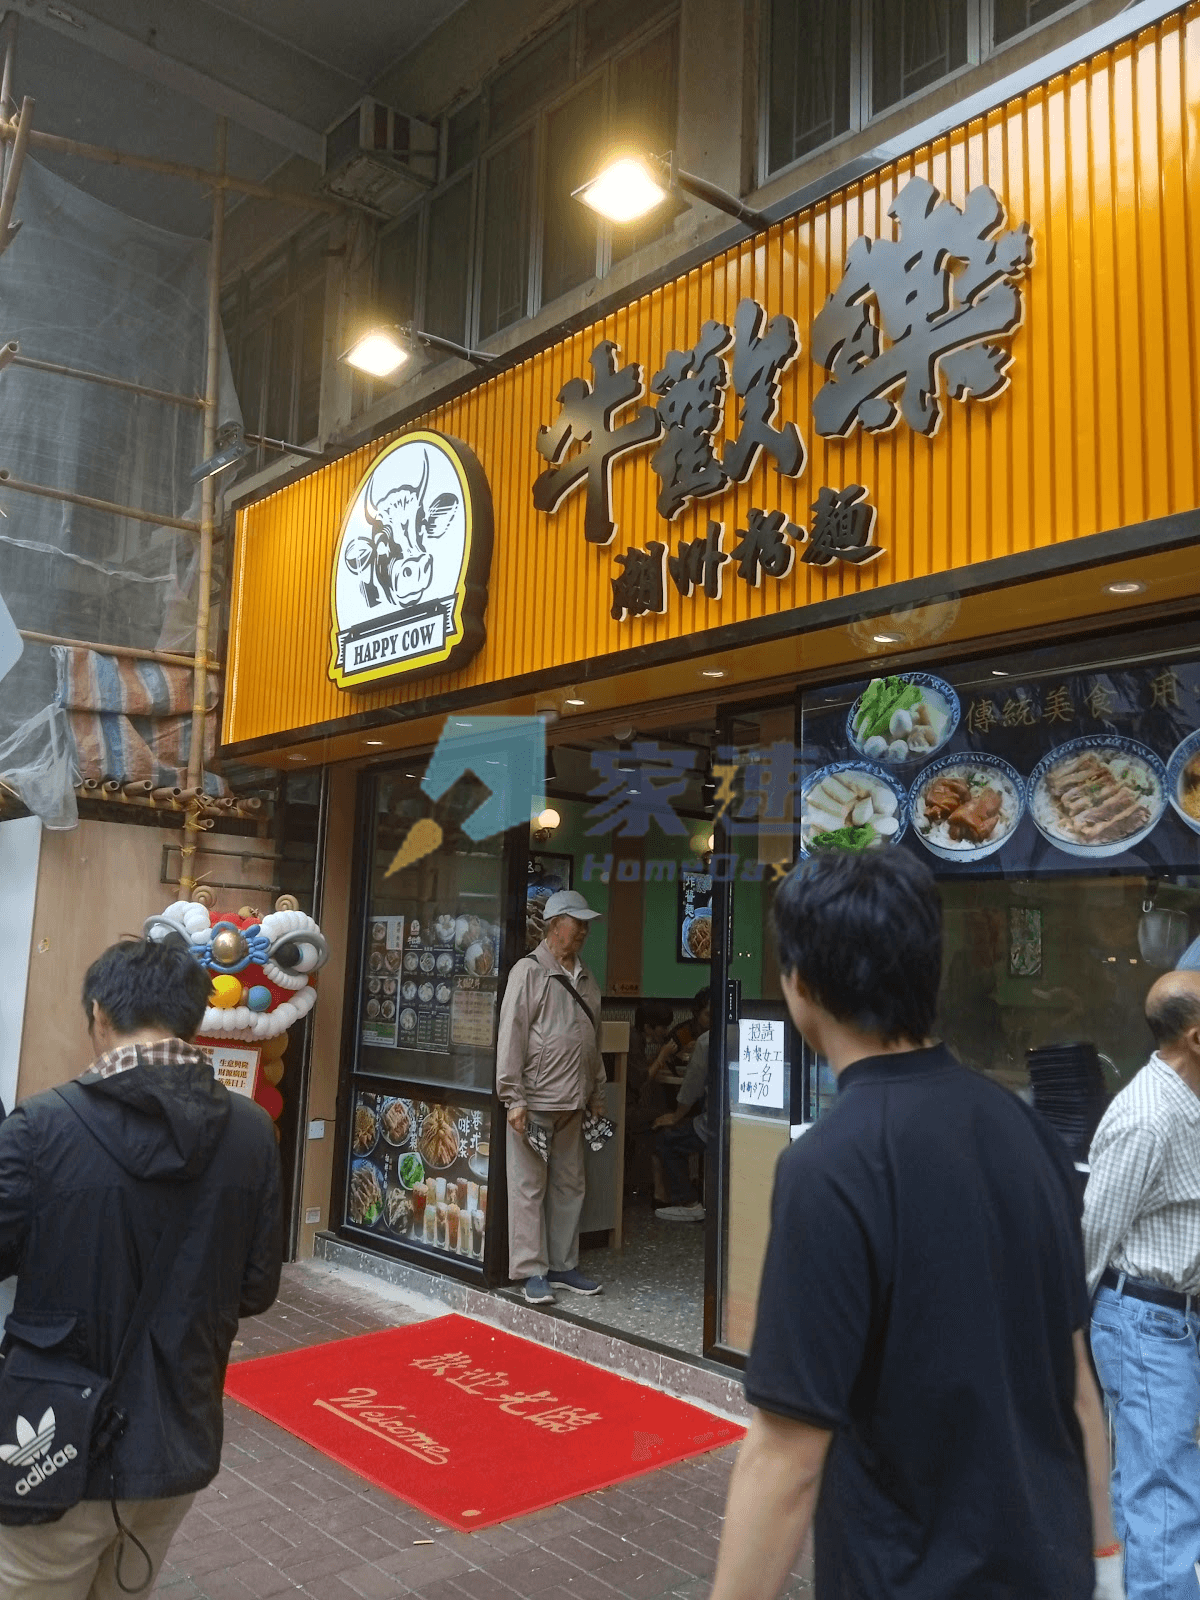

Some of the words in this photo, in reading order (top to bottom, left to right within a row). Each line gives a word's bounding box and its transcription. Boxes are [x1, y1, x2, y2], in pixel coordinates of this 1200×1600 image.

[533, 176, 1034, 544] 牛歡樂
[611, 484, 886, 621] 潮州粉麵
[353, 634, 398, 666] HAPPY
[402, 623, 435, 652] COW
[965, 683, 1118, 735] 傳統美食
[747, 1064, 772, 1083] 一名
[408, 1351, 603, 1433] 歡迎光臨
[313, 1387, 450, 1465] Welcome
[15, 1443, 78, 1496] adidas
